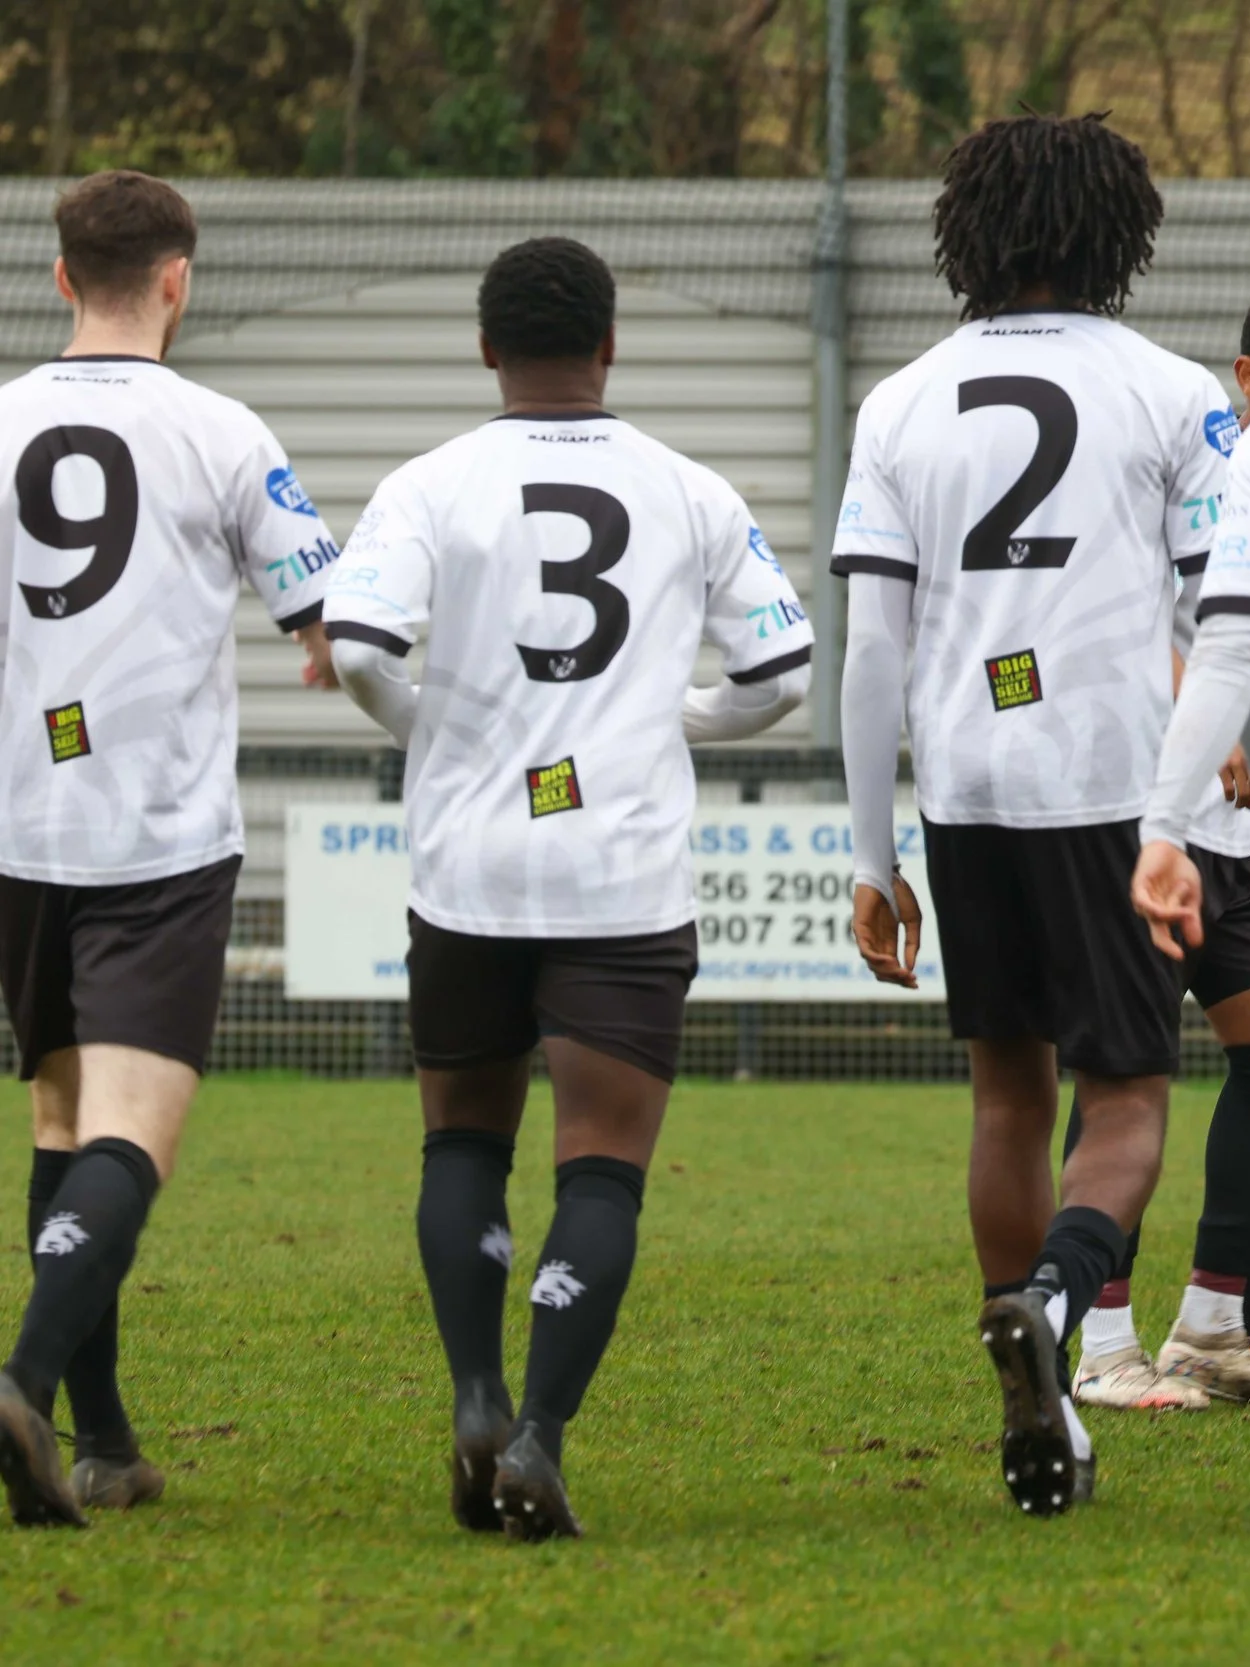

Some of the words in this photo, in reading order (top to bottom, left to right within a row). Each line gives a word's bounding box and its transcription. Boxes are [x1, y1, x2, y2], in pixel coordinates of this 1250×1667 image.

[981, 327, 1043, 337] BALHAM
[957, 375, 1079, 571] 2
[15, 424, 139, 620] 9
[515, 482, 630, 682] 3
[997, 653, 1033, 676] BIG
[995, 679, 1030, 698] SELF
[766, 826, 795, 855] &
